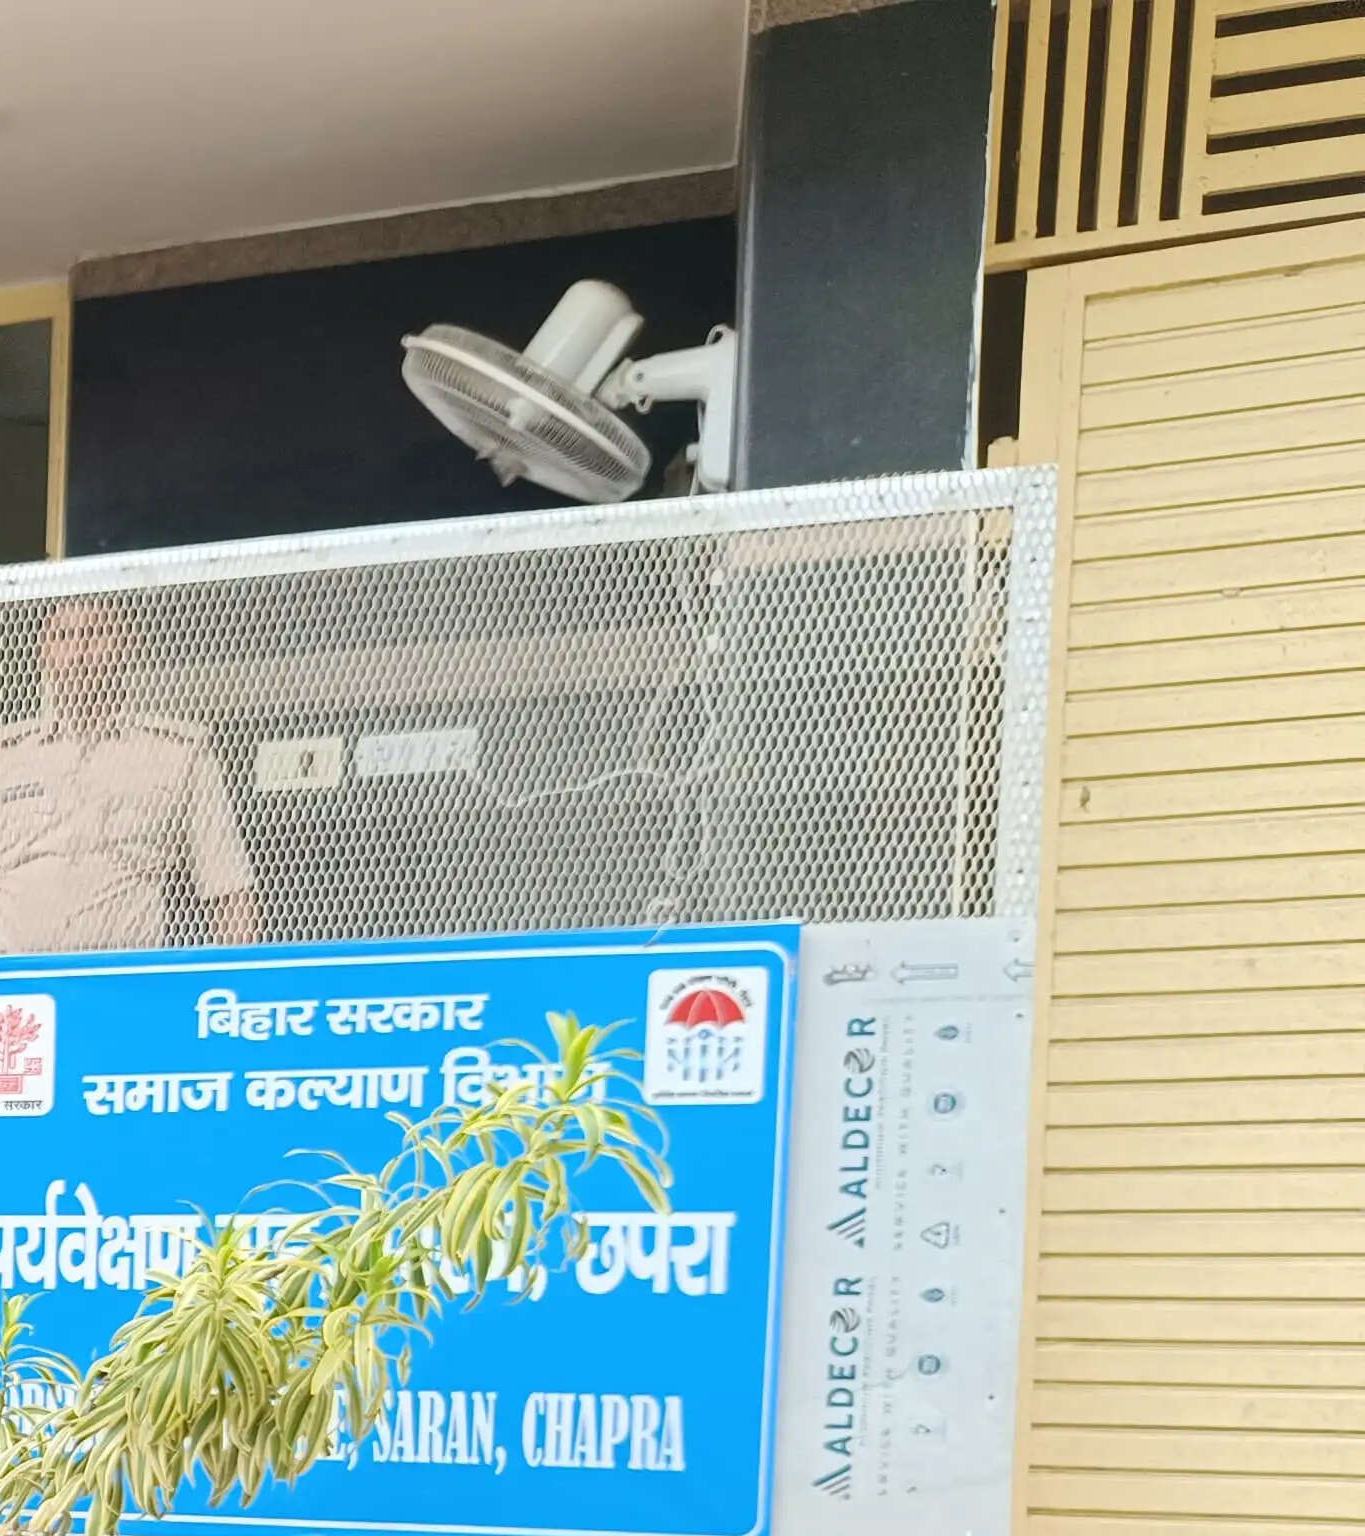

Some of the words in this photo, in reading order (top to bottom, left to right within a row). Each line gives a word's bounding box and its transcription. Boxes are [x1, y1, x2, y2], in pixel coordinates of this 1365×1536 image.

[195, 988, 318, 1041] बिहार
[326, 993, 490, 1036] सरकार
[3, 1099, 43, 1112] सरकार
[82, 1071, 234, 1116] समाज
[244, 1065, 429, 1112] कल्याण
[838, 1015, 877, 1199] ALDECOR
[573, 1210, 738, 1297] छपरा
[824, 1275, 864, 1457] ALDECOR
[372, 1389, 508, 1476] SARAN,
[521, 1391, 686, 1473] CHAPRA
